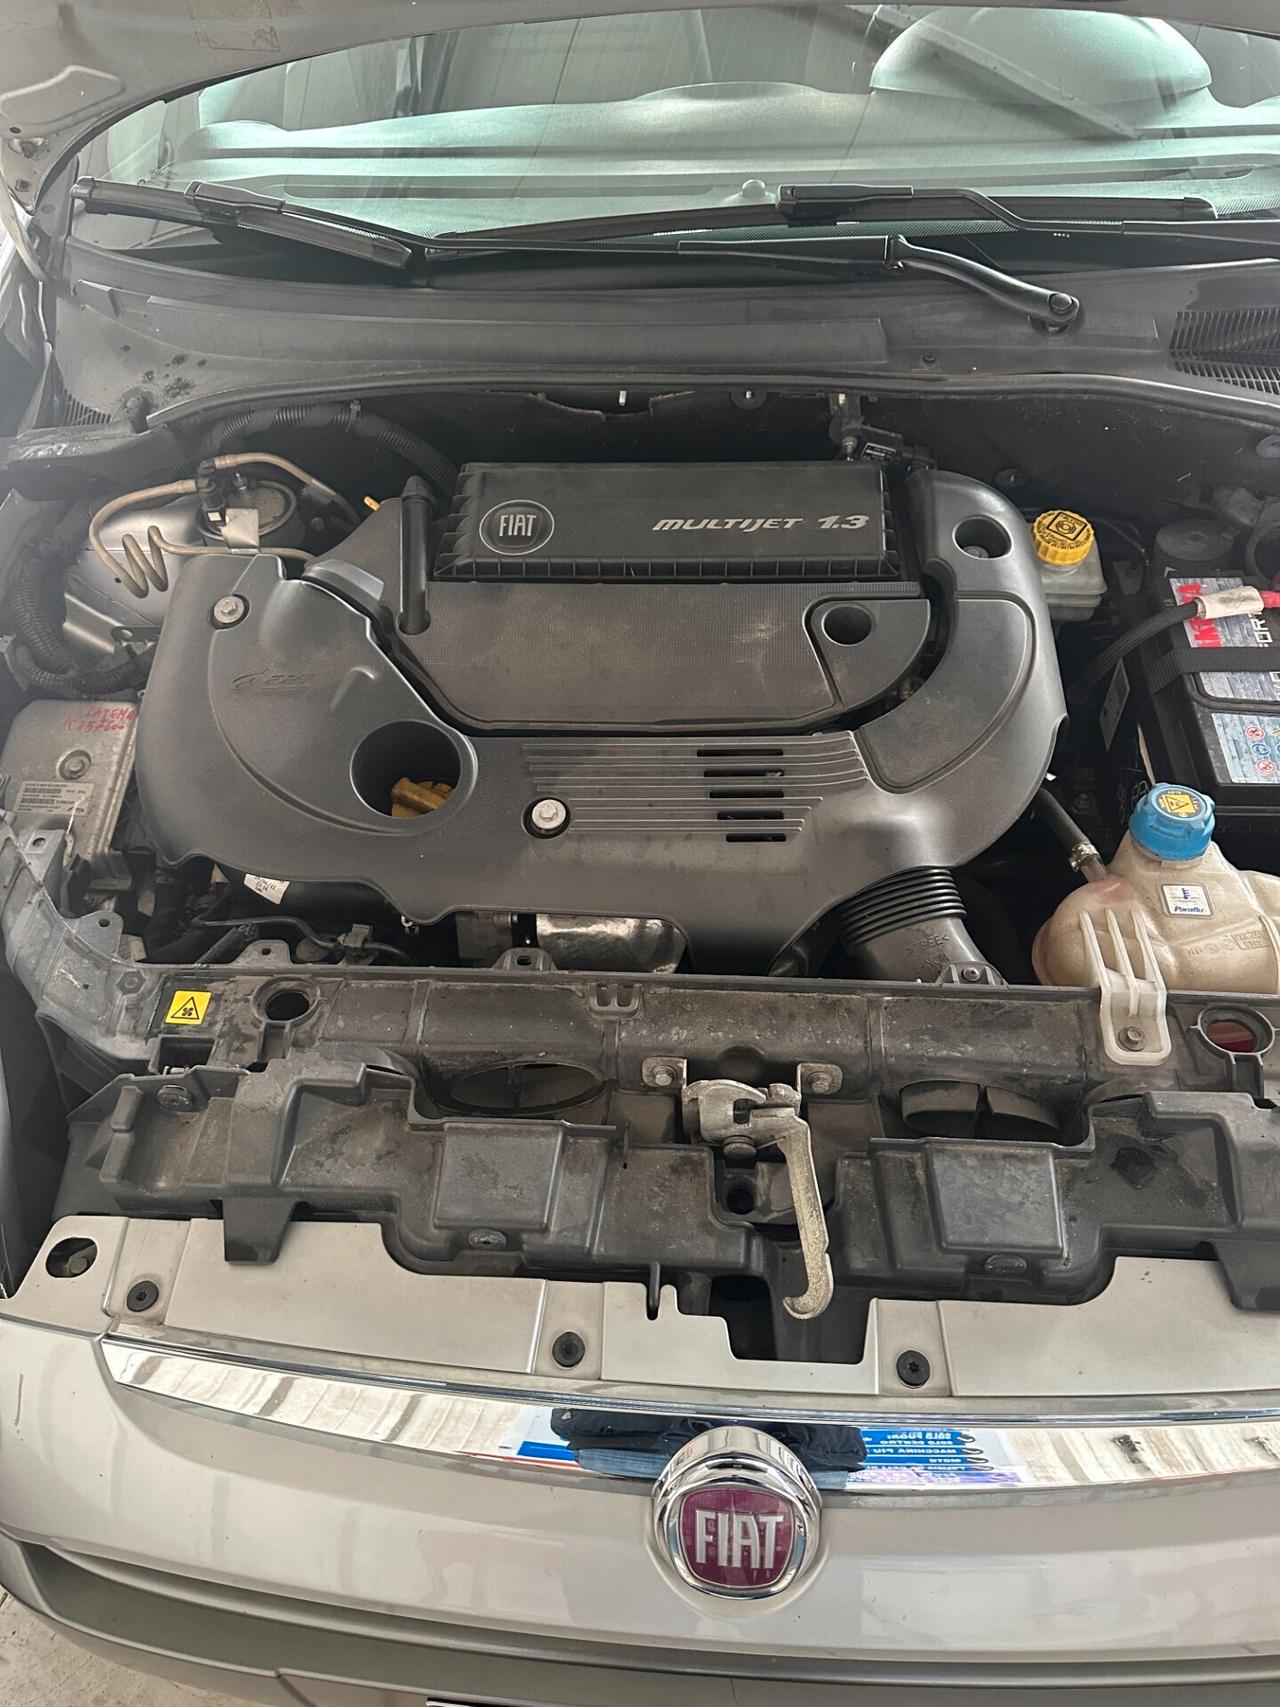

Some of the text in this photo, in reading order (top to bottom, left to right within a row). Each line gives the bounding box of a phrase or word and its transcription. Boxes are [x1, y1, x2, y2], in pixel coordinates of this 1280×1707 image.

[499, 514, 537, 537] FIAT
[652, 514, 870, 533] MULTIJET 1.3
[695, 1509, 784, 1570] FIAT
